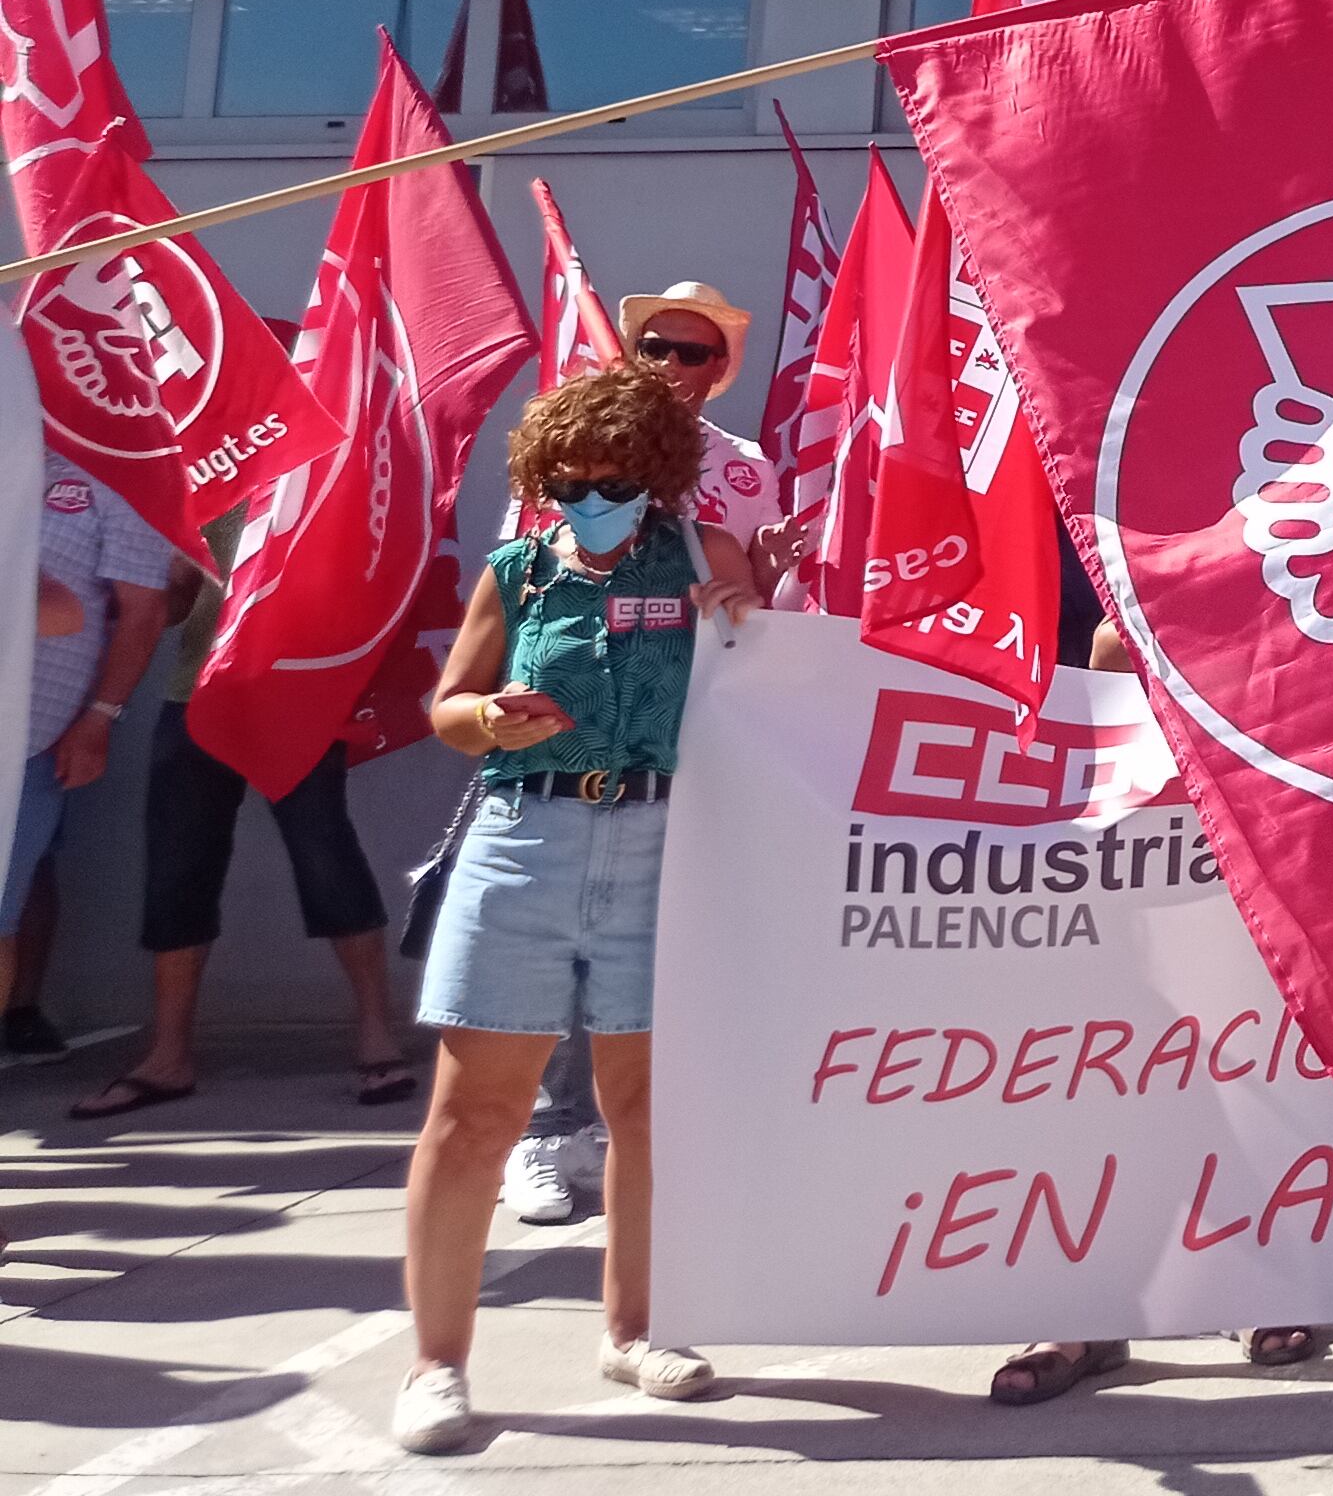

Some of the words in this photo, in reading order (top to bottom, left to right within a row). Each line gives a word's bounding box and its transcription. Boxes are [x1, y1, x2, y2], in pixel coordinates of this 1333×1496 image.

[840, 904, 1101, 949] PALENCIA
[811, 1007, 1331, 1105] FEDERACI
[876, 1153, 1118, 1297] ¡EN
